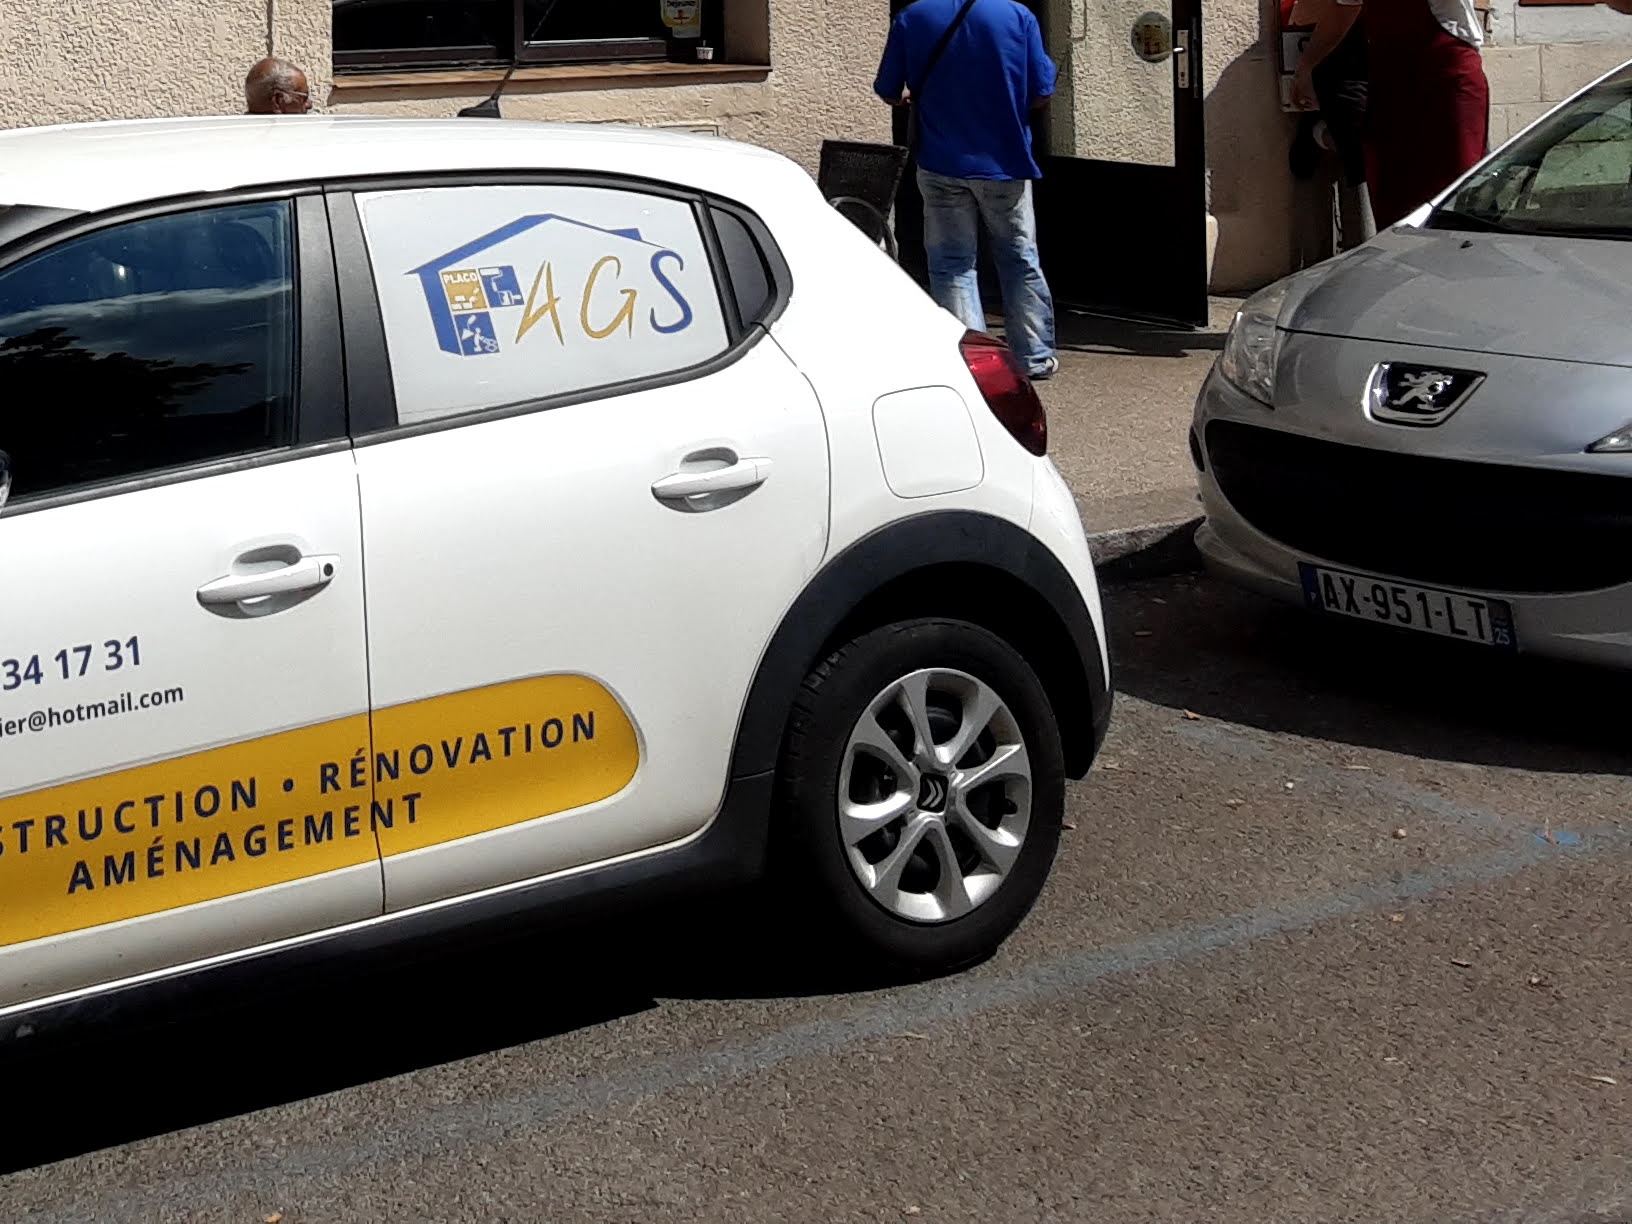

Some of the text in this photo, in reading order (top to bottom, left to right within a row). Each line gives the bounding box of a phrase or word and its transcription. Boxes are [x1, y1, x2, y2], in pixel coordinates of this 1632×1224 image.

[442, 272, 478, 284] PLACO
[514, 248, 693, 347] AGS
[1322, 572, 1486, 641] AX-951-LT
[1493, 627, 1512, 646] 25
[0, 653, 45, 693] 34
[55, 643, 94, 683] 17
[103, 633, 143, 673] 31
[317, 709, 598, 795] RÉNOVATION
[66, 791, 425, 896] AMÉNAGEMENT
